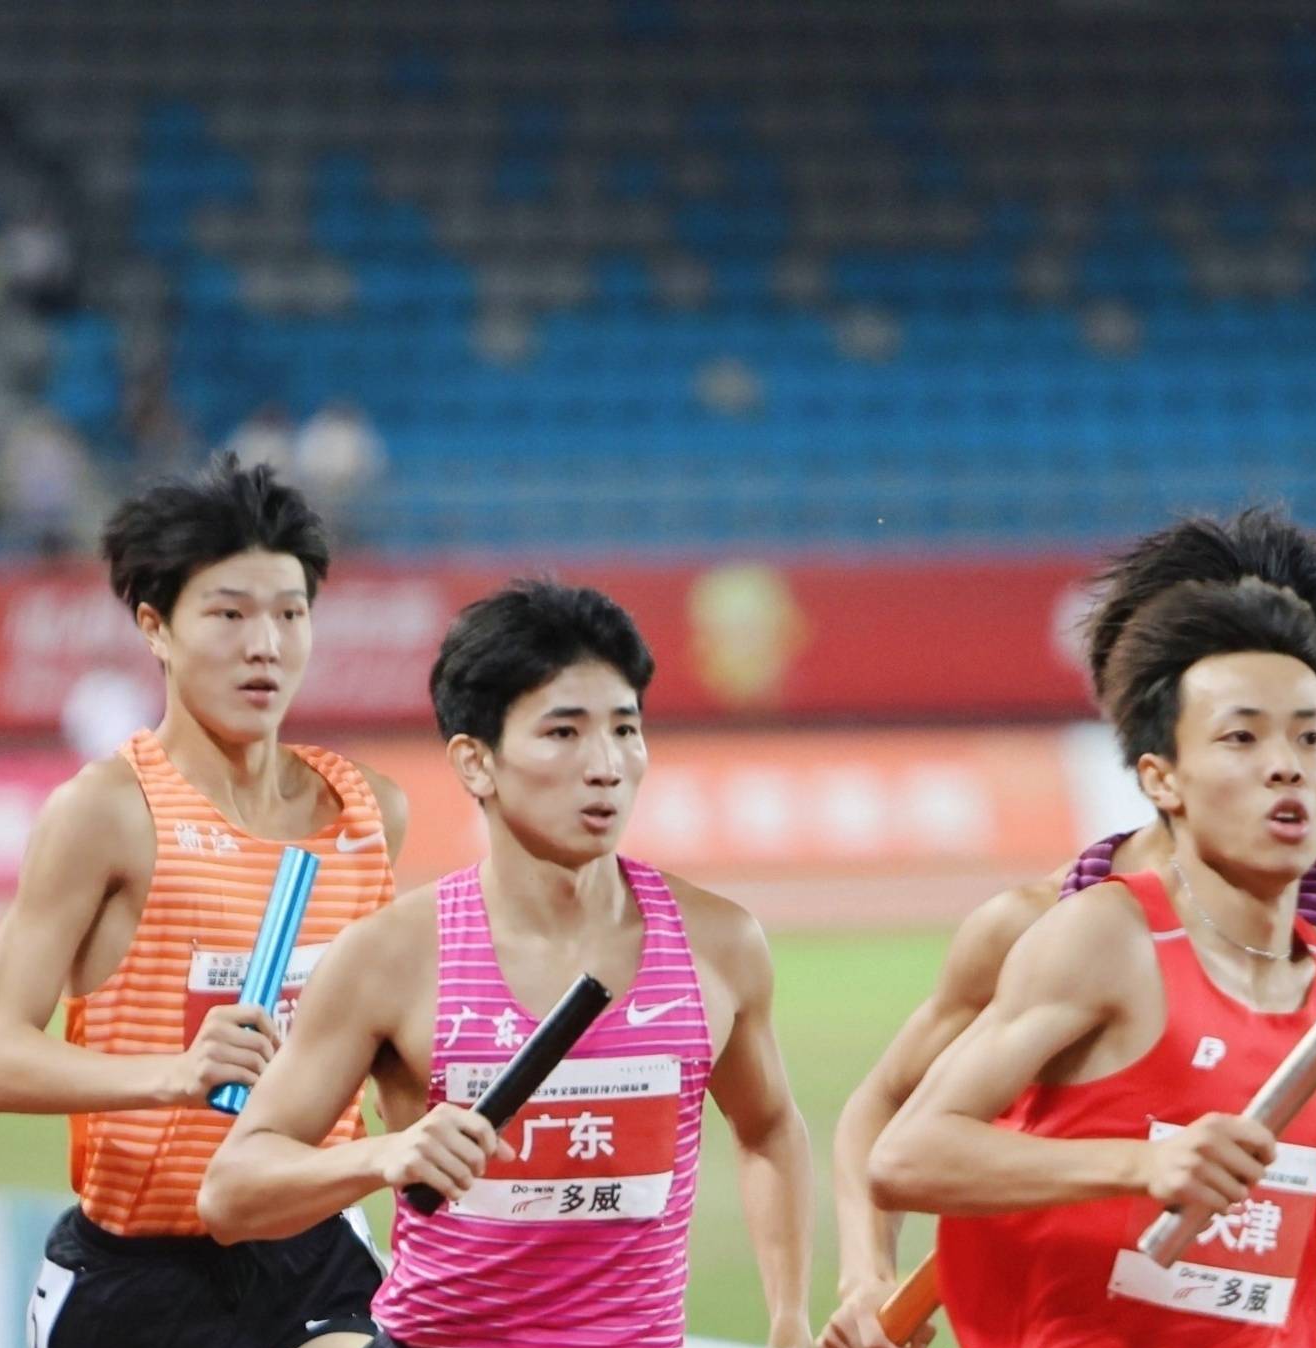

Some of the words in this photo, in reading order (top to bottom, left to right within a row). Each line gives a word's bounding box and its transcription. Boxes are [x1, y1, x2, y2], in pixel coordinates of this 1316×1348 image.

[443, 1005, 524, 1049] 广东
[519, 1111, 615, 1162] 广东
[558, 1182, 622, 1214] 多威
[1216, 1278, 1272, 1313] 多威
